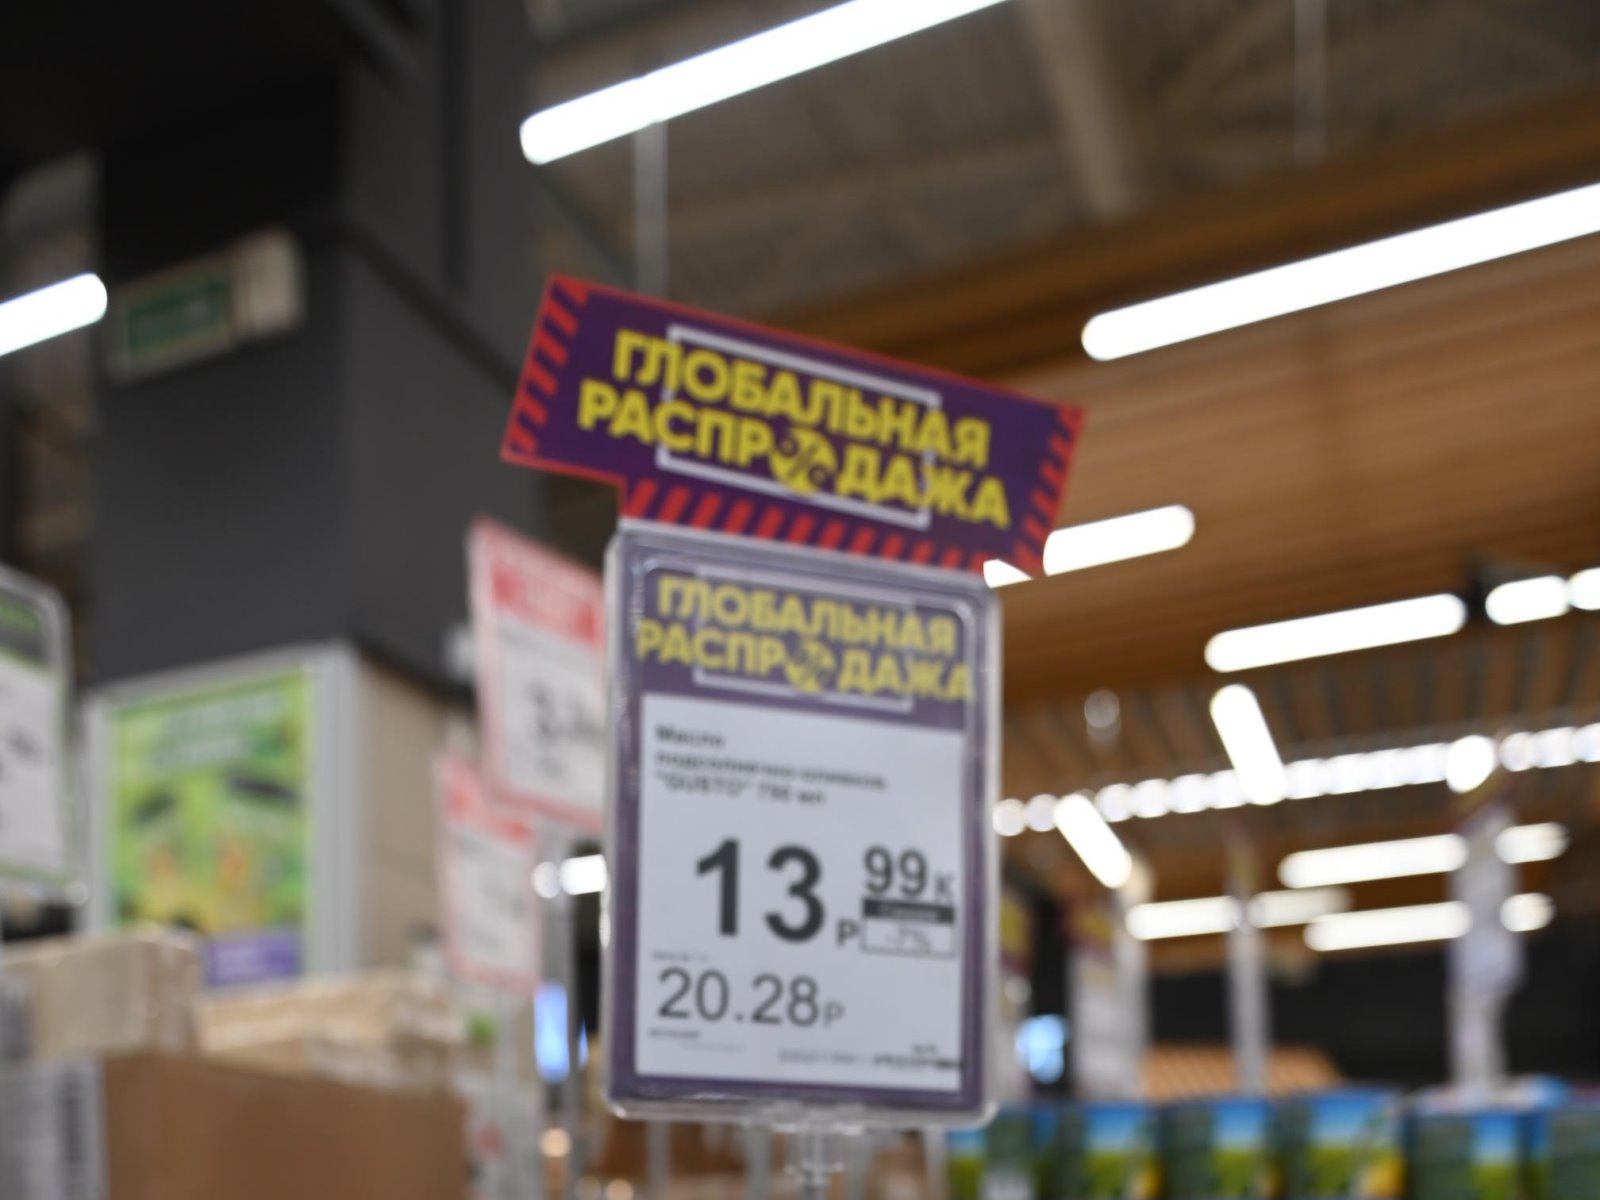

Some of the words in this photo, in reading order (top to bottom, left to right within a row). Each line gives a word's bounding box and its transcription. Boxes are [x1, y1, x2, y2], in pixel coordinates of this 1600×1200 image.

[612, 329, 992, 468] ГЛОБАЛЬНАЯ
[657, 575, 958, 655] ГЛОБАЛЬНАЯ
[696, 836, 827, 944] 13
[863, 845, 928, 899] 99
[656, 965, 820, 1028] 20.28
